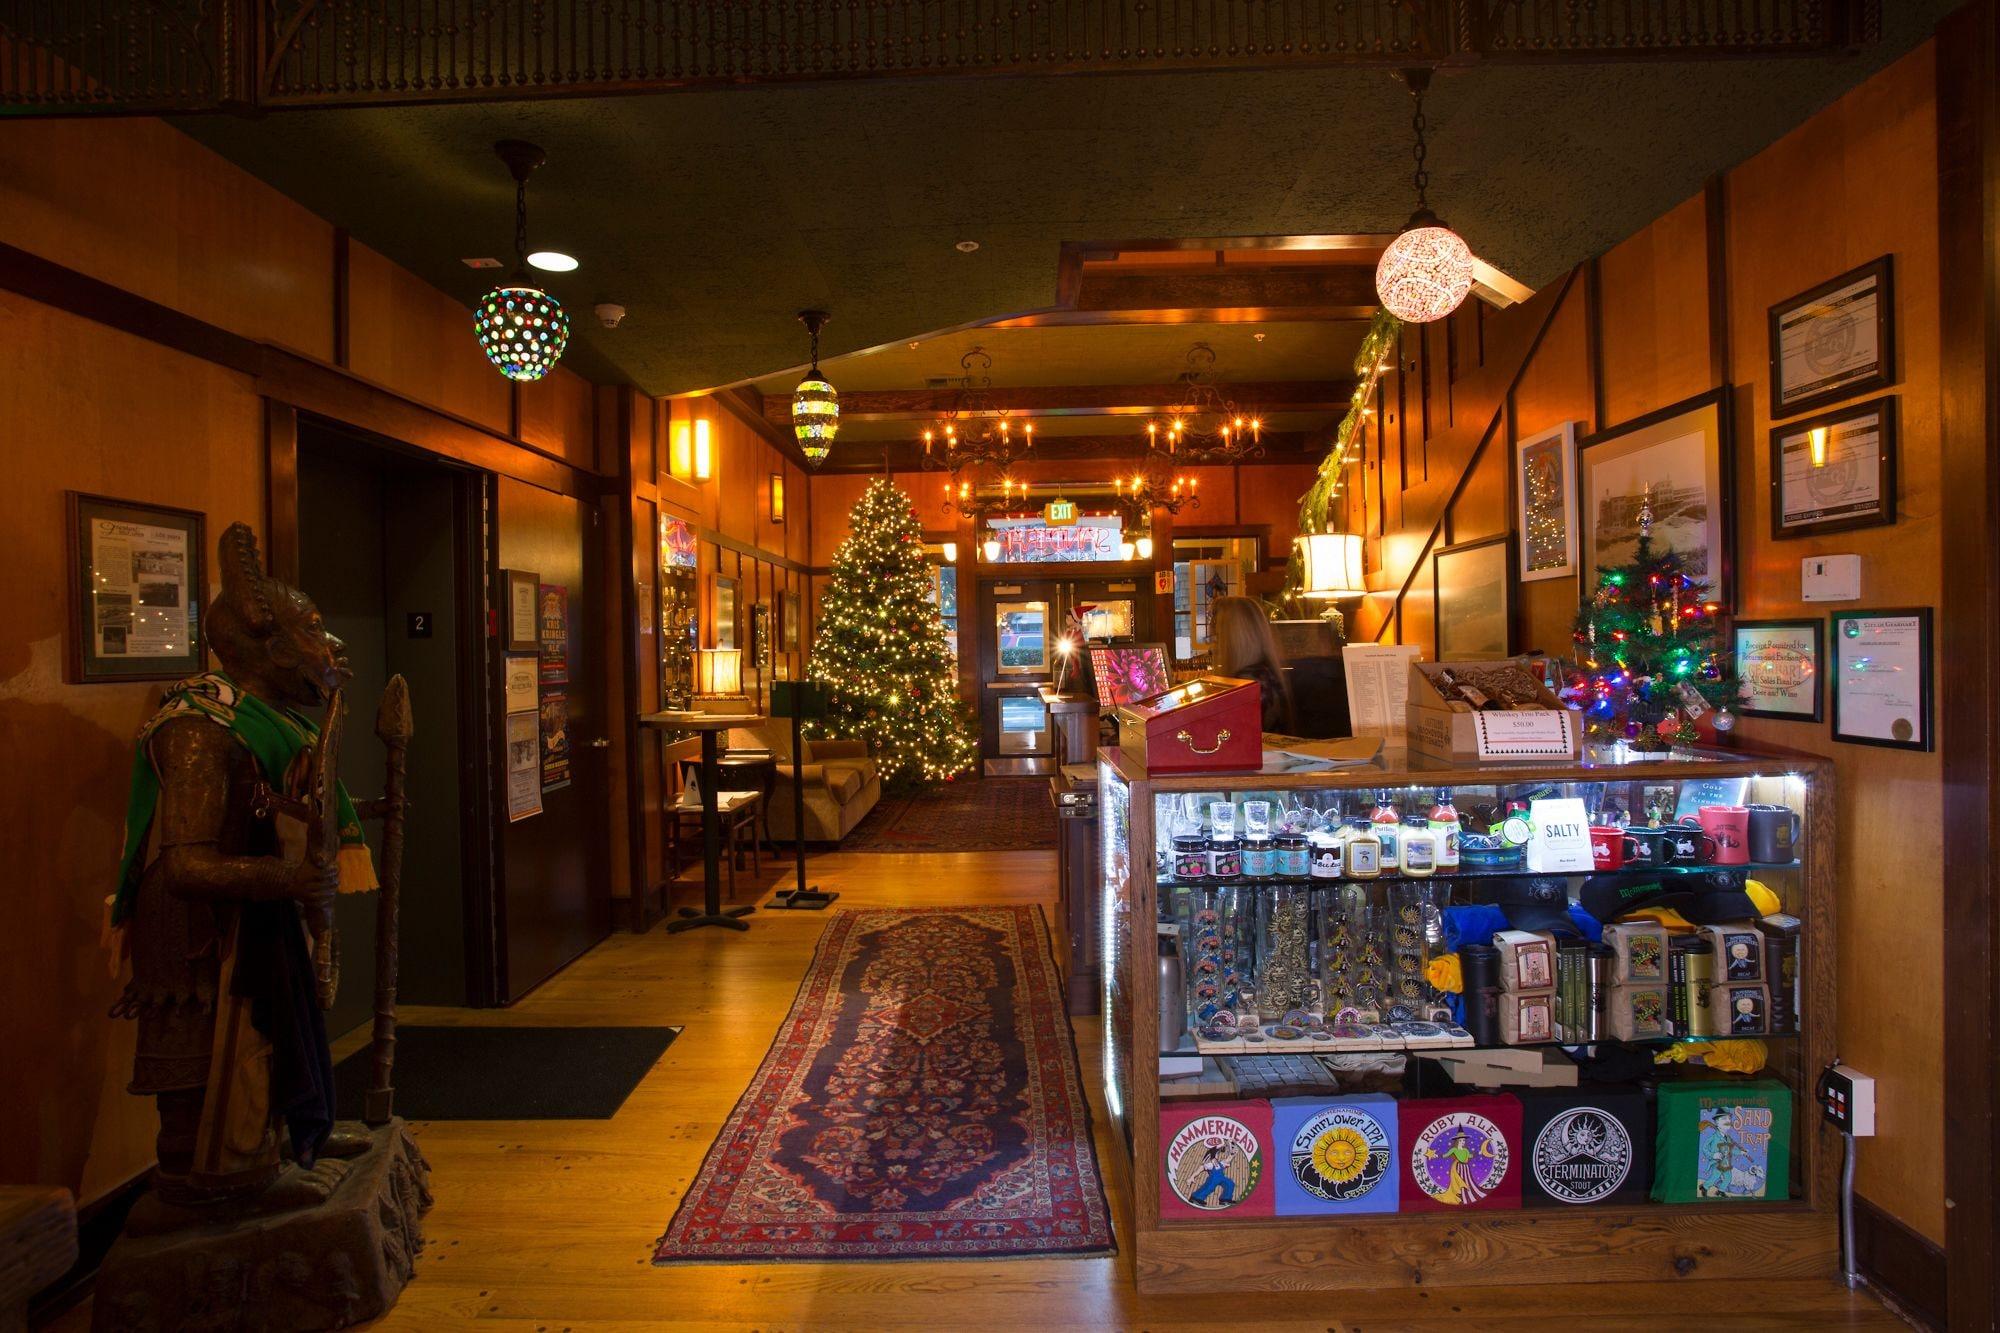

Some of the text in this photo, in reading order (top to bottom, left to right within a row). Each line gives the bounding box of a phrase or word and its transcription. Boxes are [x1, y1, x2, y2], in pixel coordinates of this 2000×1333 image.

[1050, 503, 1072, 520] EXIT
[415, 615, 424, 632] 2
[546, 619, 560, 630] KRIS
[541, 629, 566, 639] KRINGLE
[548, 644, 560, 653] ALE
[1768, 640, 1795, 651] Required
[1796, 639, 1808, 649] for
[1760, 675, 1775, 685] Sales
[1776, 675, 1792, 684] Final
[1752, 687, 1798, 698] Beer and Wine
[1492, 711, 1519, 719] Whiskey
[1545, 823, 1580, 838] SALTY
[1733, 1106, 1772, 1131] SAND
[1361, 1120, 1384, 1146] IPA
[1421, 1113, 1496, 1143] RUBY ALE
[1169, 1119, 1255, 1161] HAMMERHEAD
[1738, 1130, 1772, 1157] TRAP
[1547, 1162, 1617, 1182] TERMINATOR
[1569, 1180, 1591, 1190] STOUT
